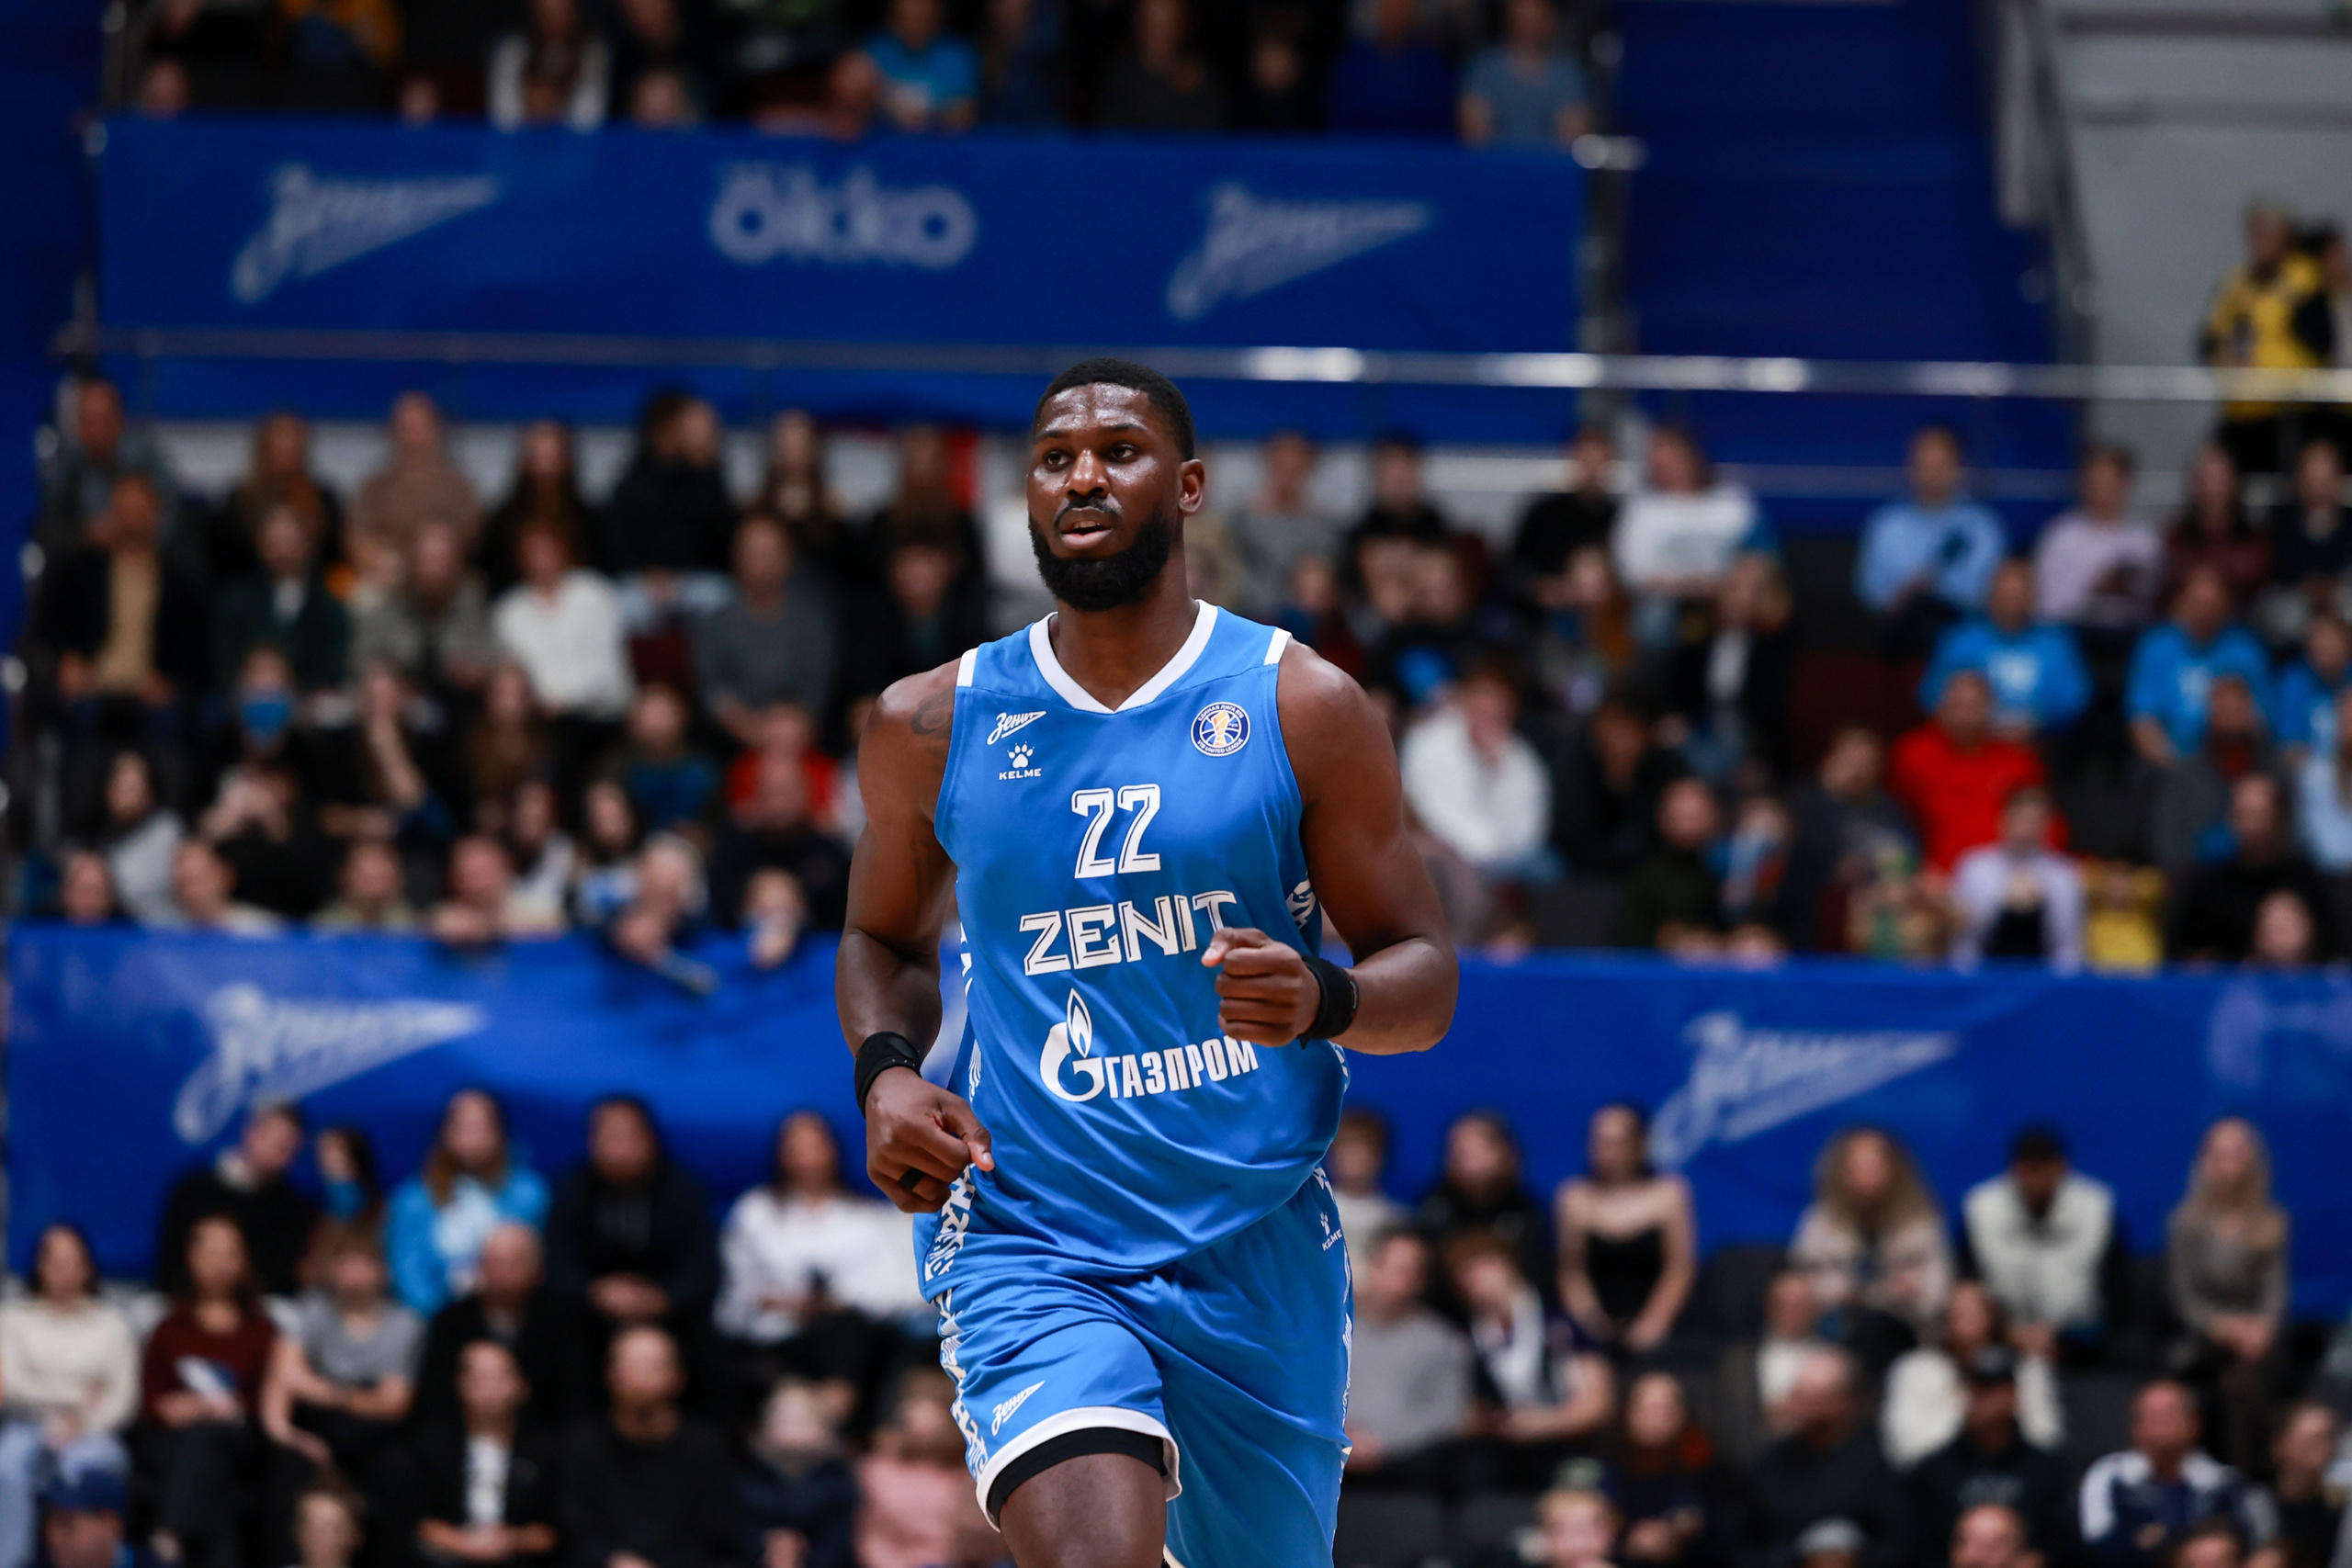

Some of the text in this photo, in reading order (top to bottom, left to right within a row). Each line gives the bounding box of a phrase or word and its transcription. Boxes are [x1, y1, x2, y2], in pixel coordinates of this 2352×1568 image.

[999, 768, 1042, 780] KELME
[1225, 738, 1244, 751] LEAGUE
[1071, 784, 1160, 878] 22
[1019, 890, 1238, 976] ZENIT
[1104, 1034, 1259, 1099] ГАЗПРОМ
